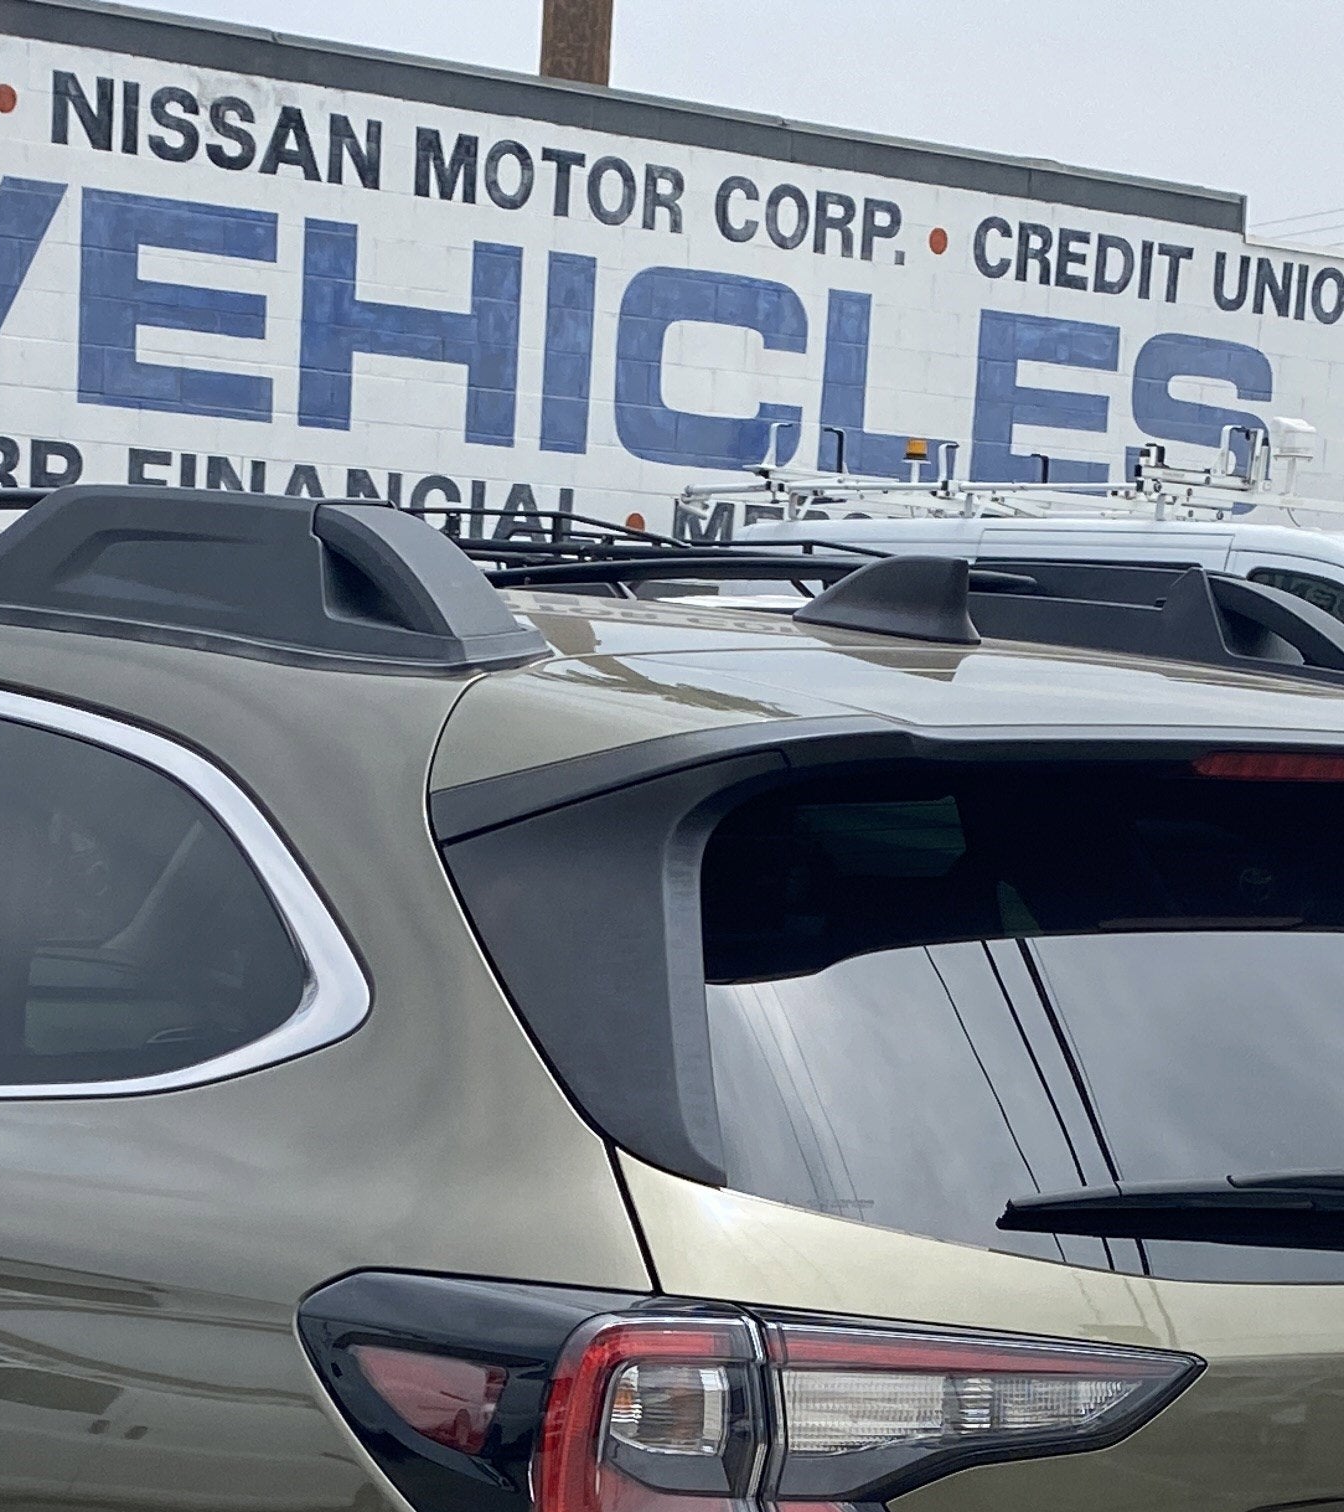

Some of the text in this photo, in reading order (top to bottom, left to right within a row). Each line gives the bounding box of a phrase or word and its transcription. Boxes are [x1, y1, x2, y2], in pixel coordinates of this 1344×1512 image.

[51, 69, 383, 191] NISSAN
[415, 126, 685, 234] MOTOR
[715, 175, 905, 265] CORP.
[973, 215, 1194, 303] CREDIT
